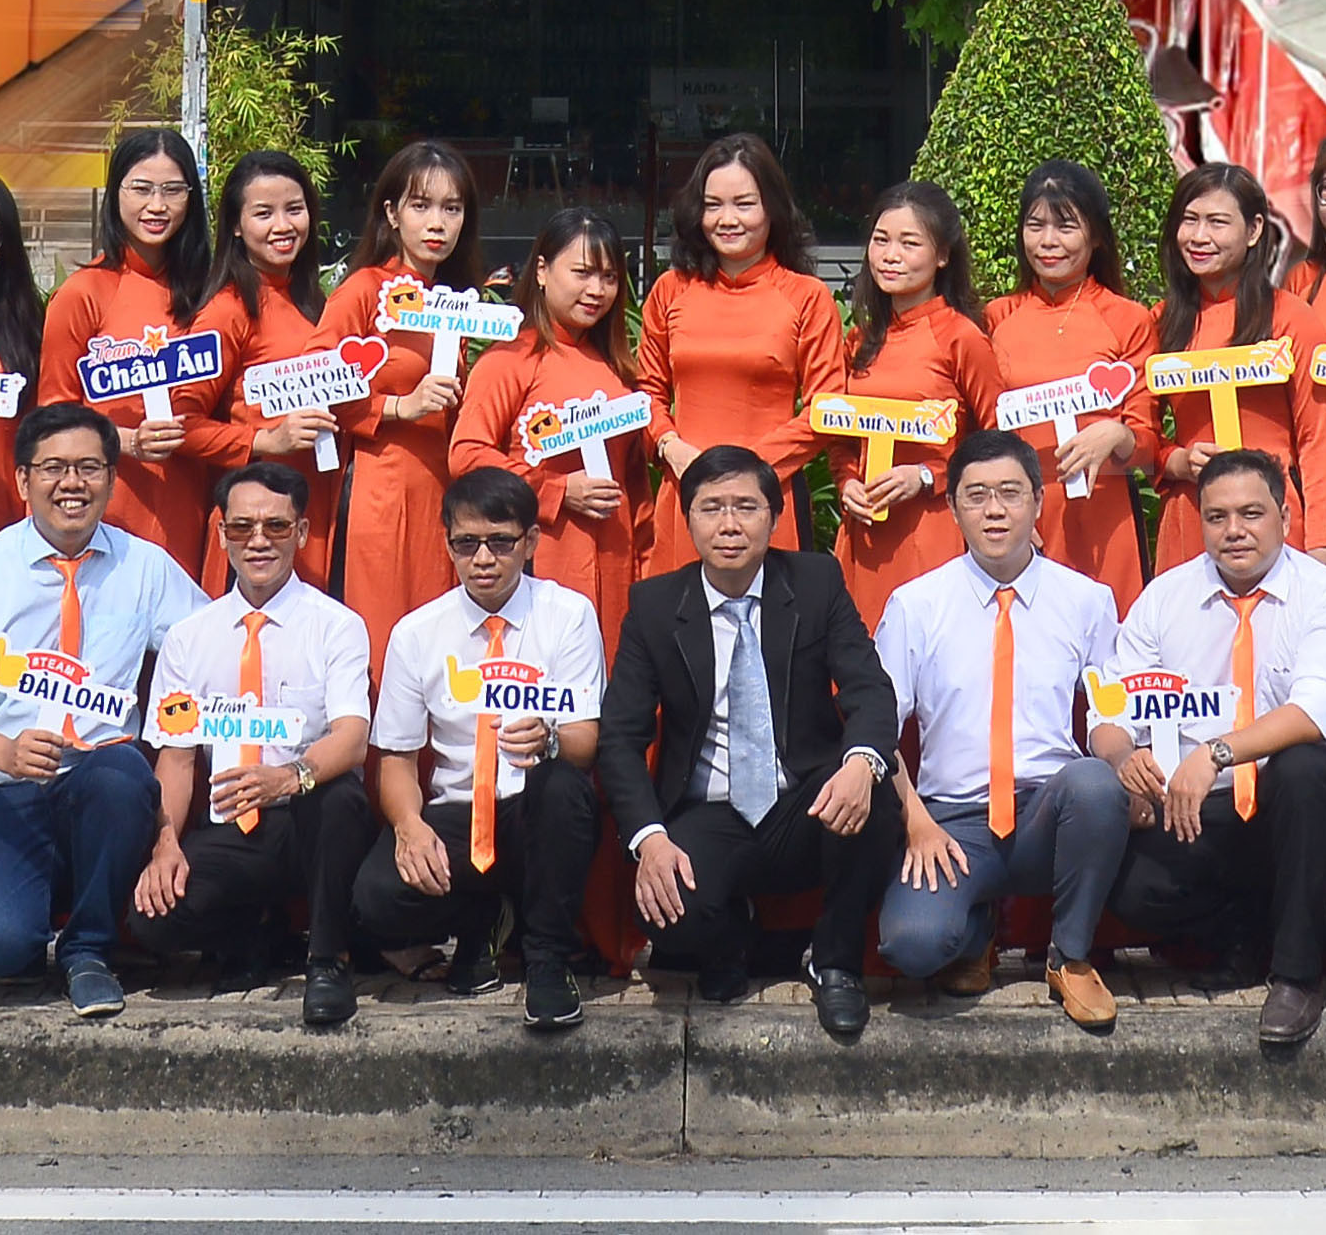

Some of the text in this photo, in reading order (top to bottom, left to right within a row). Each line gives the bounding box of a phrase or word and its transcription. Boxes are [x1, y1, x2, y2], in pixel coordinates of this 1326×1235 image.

[399, 311, 441, 329] TOUR
[90, 344, 214, 394] Châu Âu
[250, 363, 361, 400] SINGAPORE
[275, 357, 330, 376] HAIDANG
[1155, 372, 1185, 387] BAY
[269, 381, 364, 413] MALAYSIA
[1026, 382, 1082, 404] HAIDANG
[823, 413, 853, 428] BAY
[1003, 390, 1112, 428] AUSTRALIA
[541, 407, 647, 451] TOUR LIMOUSINE
[18, 671, 124, 718] ĐÀI LOAN
[485, 683, 575, 713] KOREA
[1131, 691, 1220, 721] JAPAN
[203, 715, 288, 743] NỘI ĐỊA
